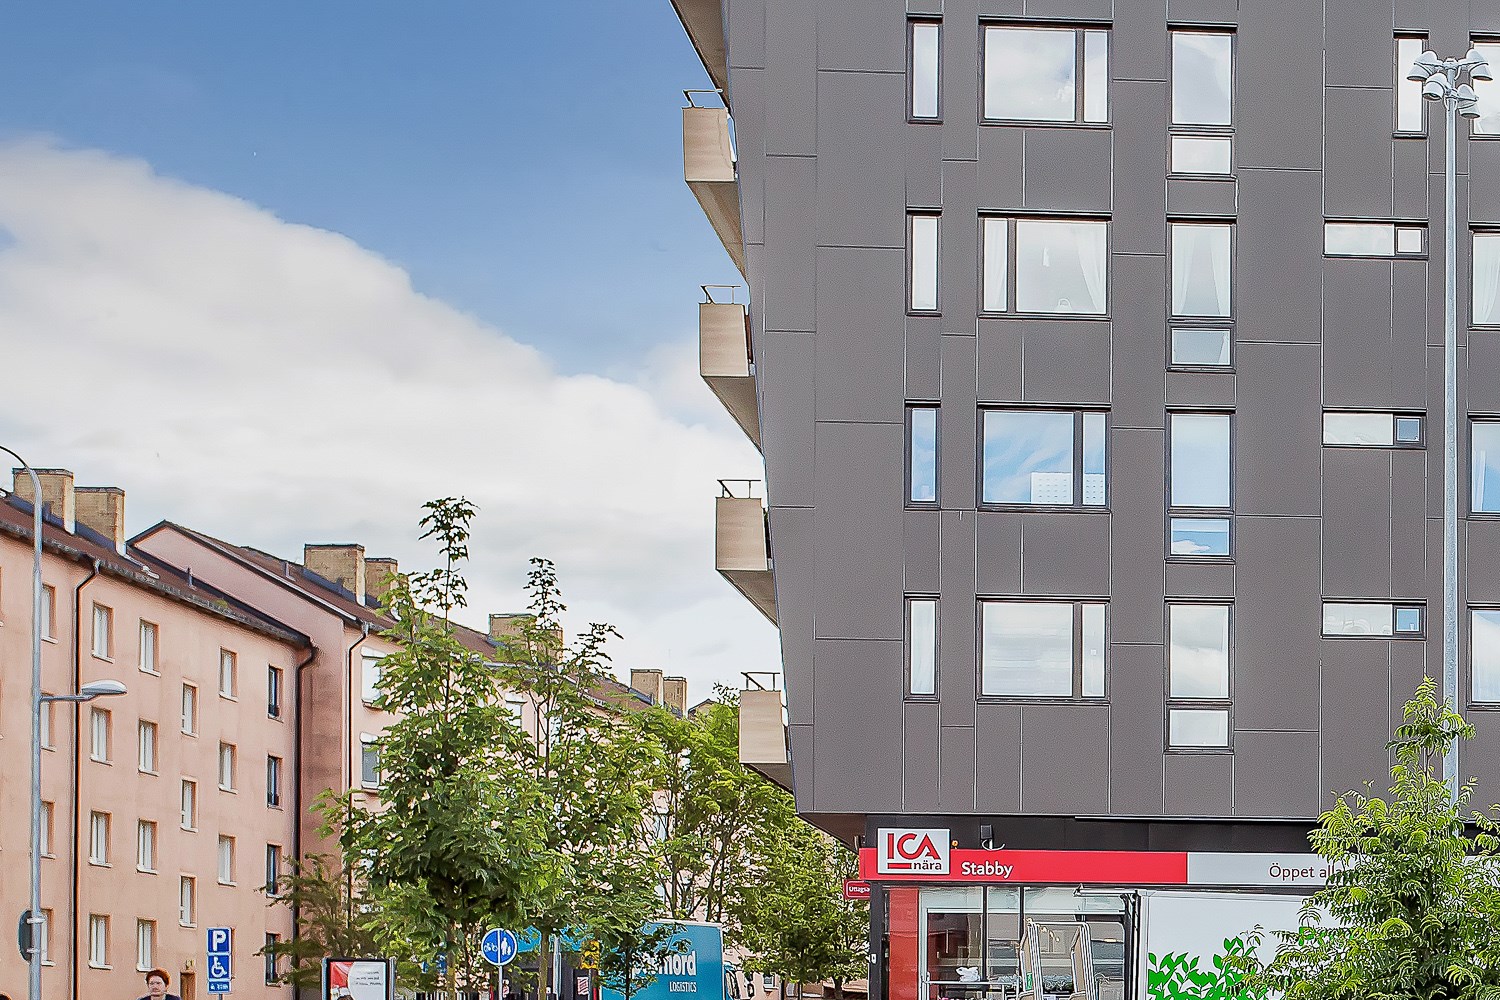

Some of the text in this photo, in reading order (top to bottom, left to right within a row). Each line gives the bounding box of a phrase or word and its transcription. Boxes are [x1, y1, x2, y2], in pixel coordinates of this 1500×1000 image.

[887, 833, 941, 860] ICA
[913, 860, 942, 871] nära
[961, 861, 1013, 878] Stabby
[1269, 863, 1315, 881] Öppet
[212, 930, 227, 951] P
[669, 981, 697, 992] LOGISTICS
